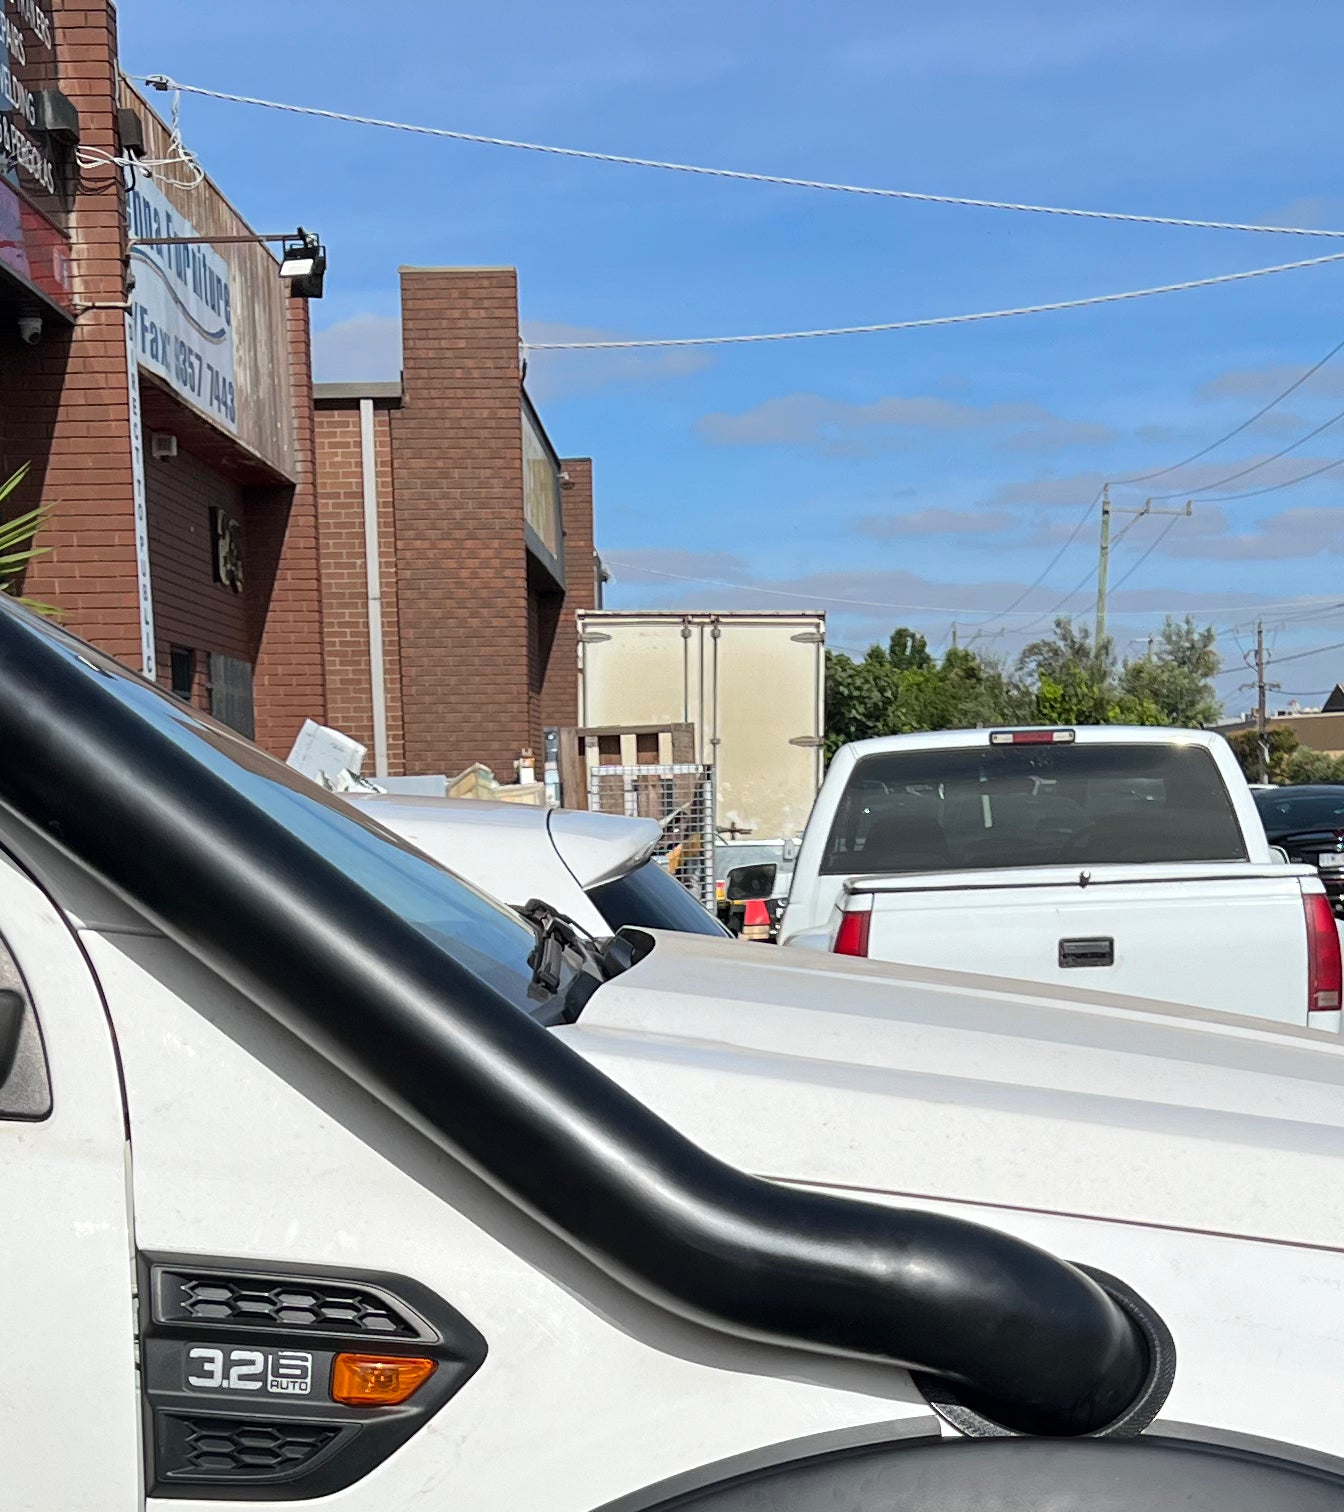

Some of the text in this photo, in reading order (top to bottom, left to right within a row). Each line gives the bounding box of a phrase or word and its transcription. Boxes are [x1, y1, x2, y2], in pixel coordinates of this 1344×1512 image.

[165, 209, 232, 327] Furniture
[206, 363, 236, 423] 7443
[187, 1347, 265, 1390] 3.2
[269, 1379, 309, 1392] AUTO
